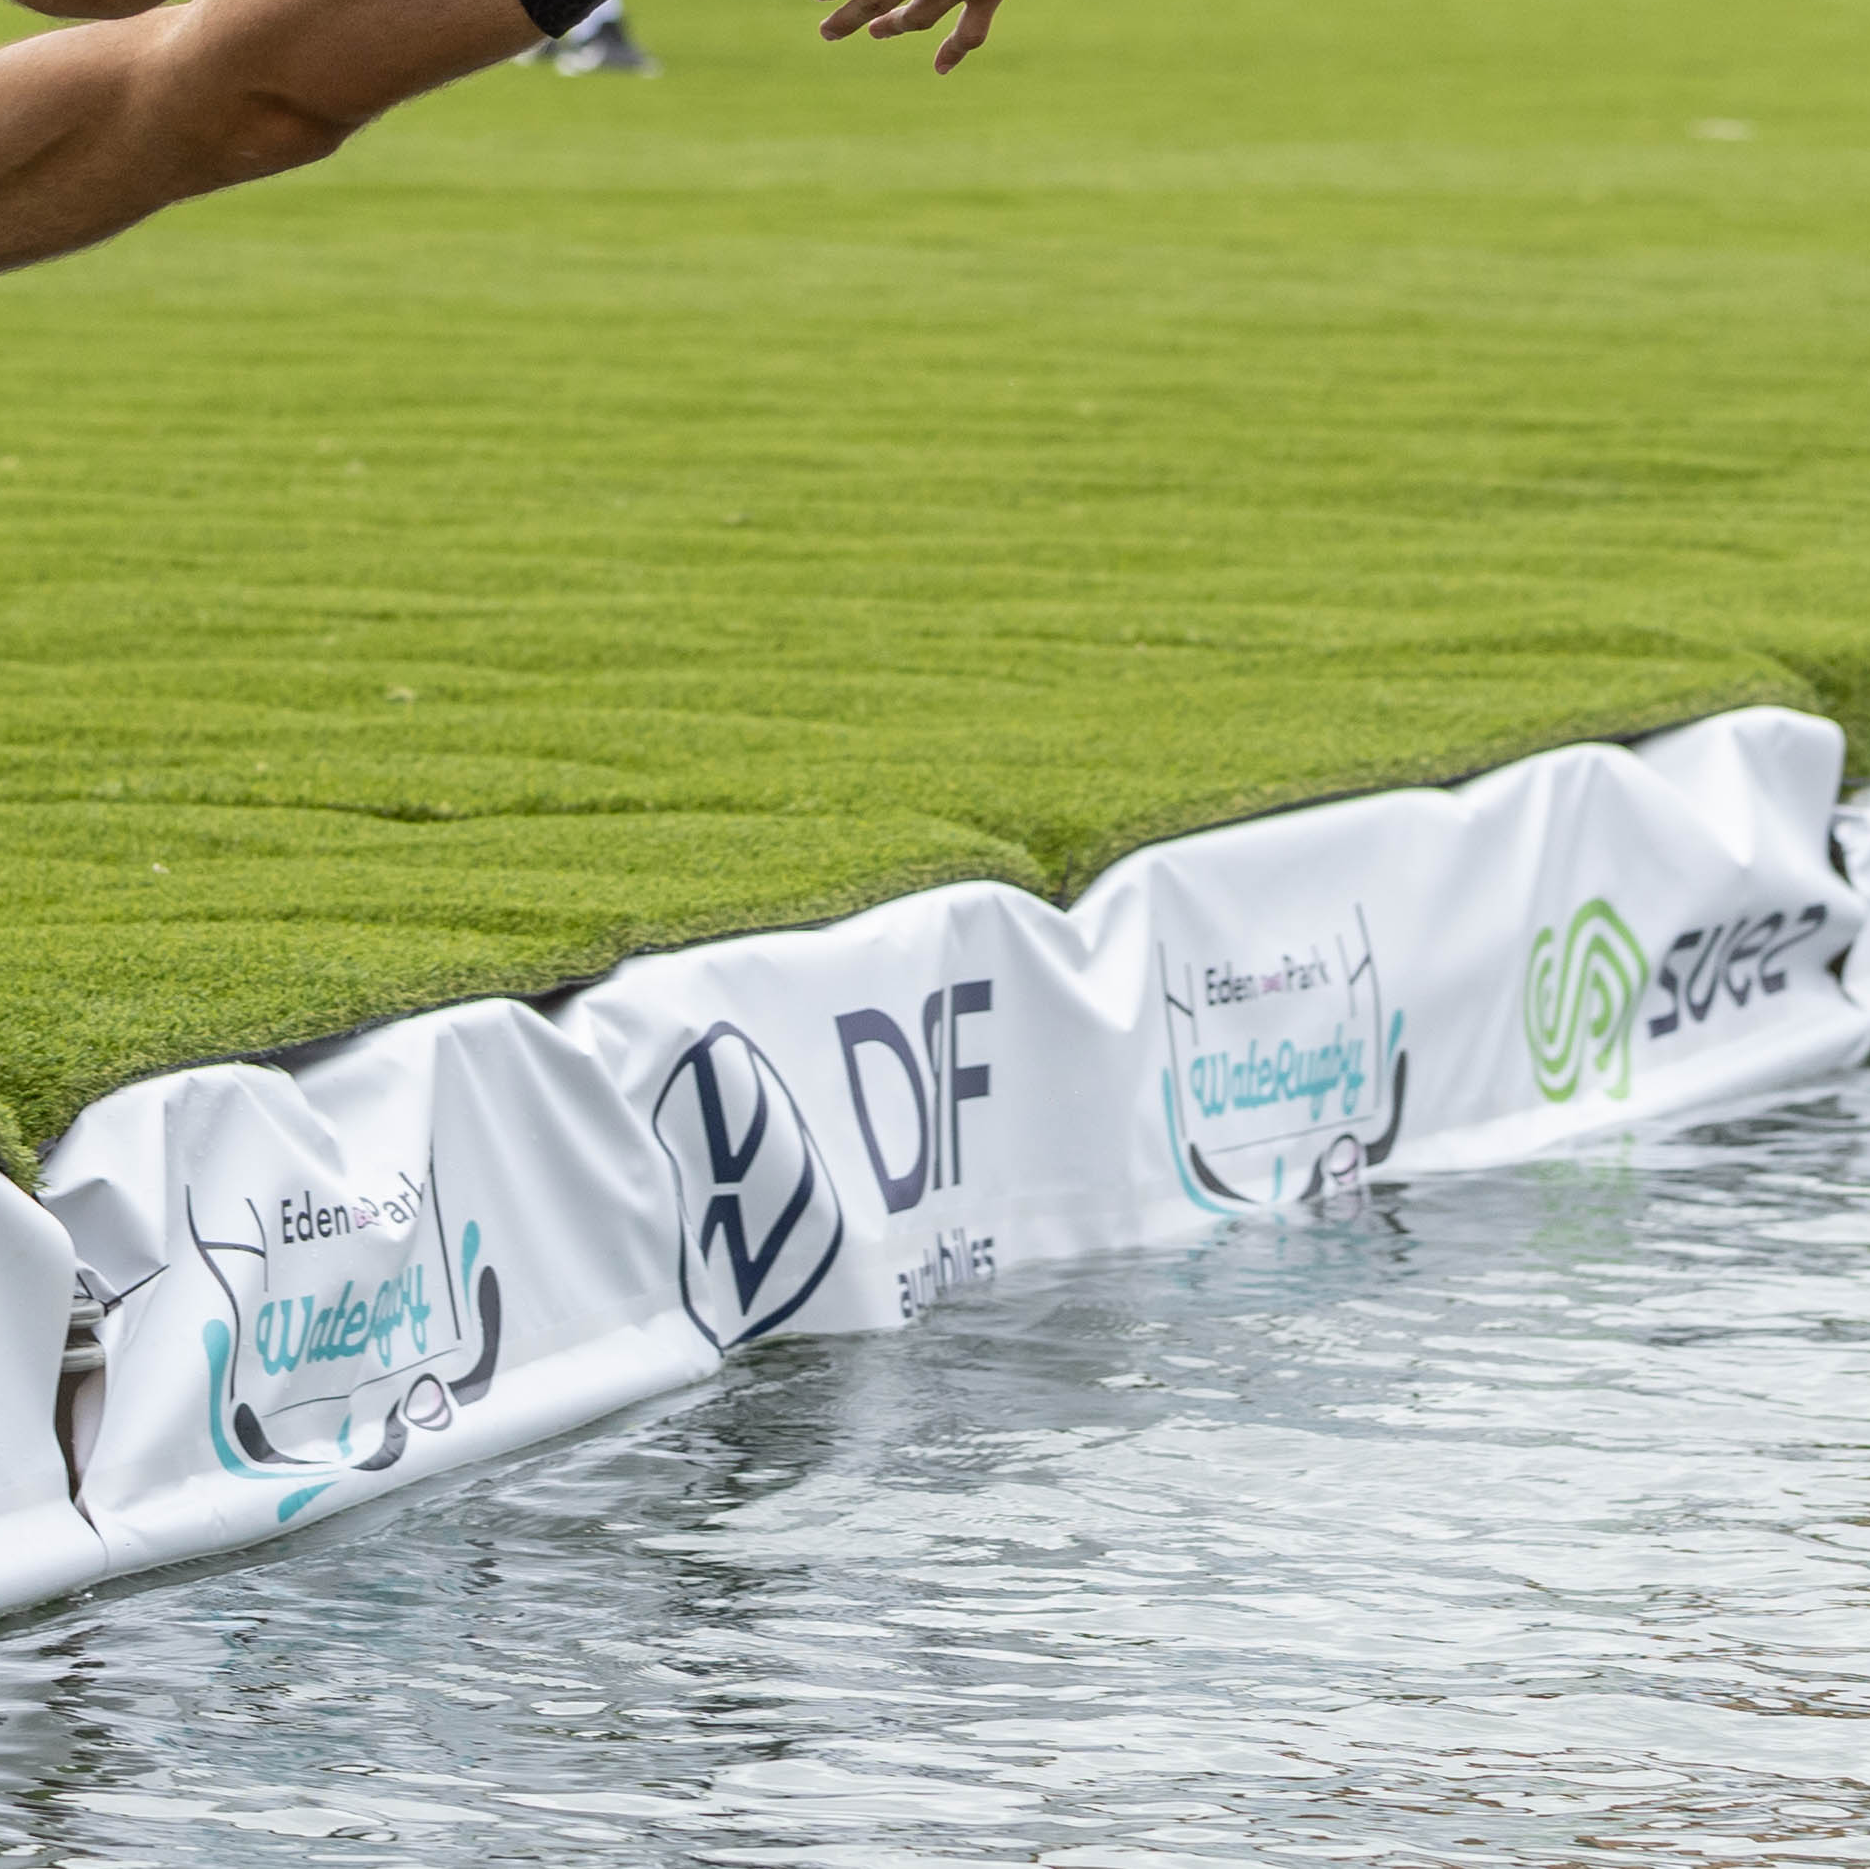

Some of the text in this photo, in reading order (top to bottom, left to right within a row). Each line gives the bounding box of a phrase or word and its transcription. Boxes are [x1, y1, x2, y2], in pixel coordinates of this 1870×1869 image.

[1205, 960, 1259, 1006] Eden
[1189, 1022, 1366, 1124] WateRugby
[281, 1190, 351, 1244] Eden
